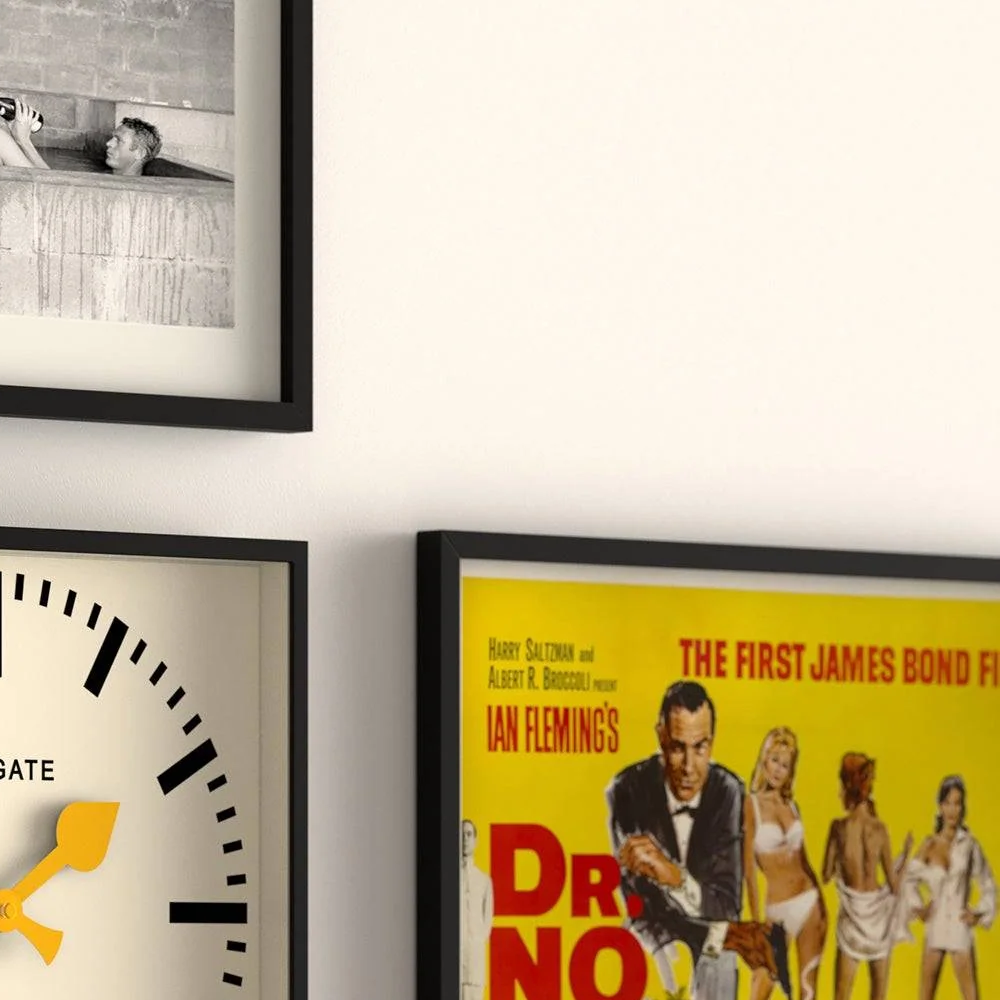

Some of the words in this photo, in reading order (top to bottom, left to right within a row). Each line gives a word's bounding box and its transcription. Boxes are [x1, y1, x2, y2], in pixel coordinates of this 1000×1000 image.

[488, 637, 521, 661] HARRY
[525, 637, 575, 662] SALTZMAN
[679, 638, 727, 677] THE
[736, 641, 805, 681] FIRST
[810, 643, 895, 683] JAMES
[903, 648, 970, 686] BOND
[488, 665, 524, 689] ALBERT
[487, 705, 518, 752] IAN
[525, 700, 619, 753] FLEMING'S
